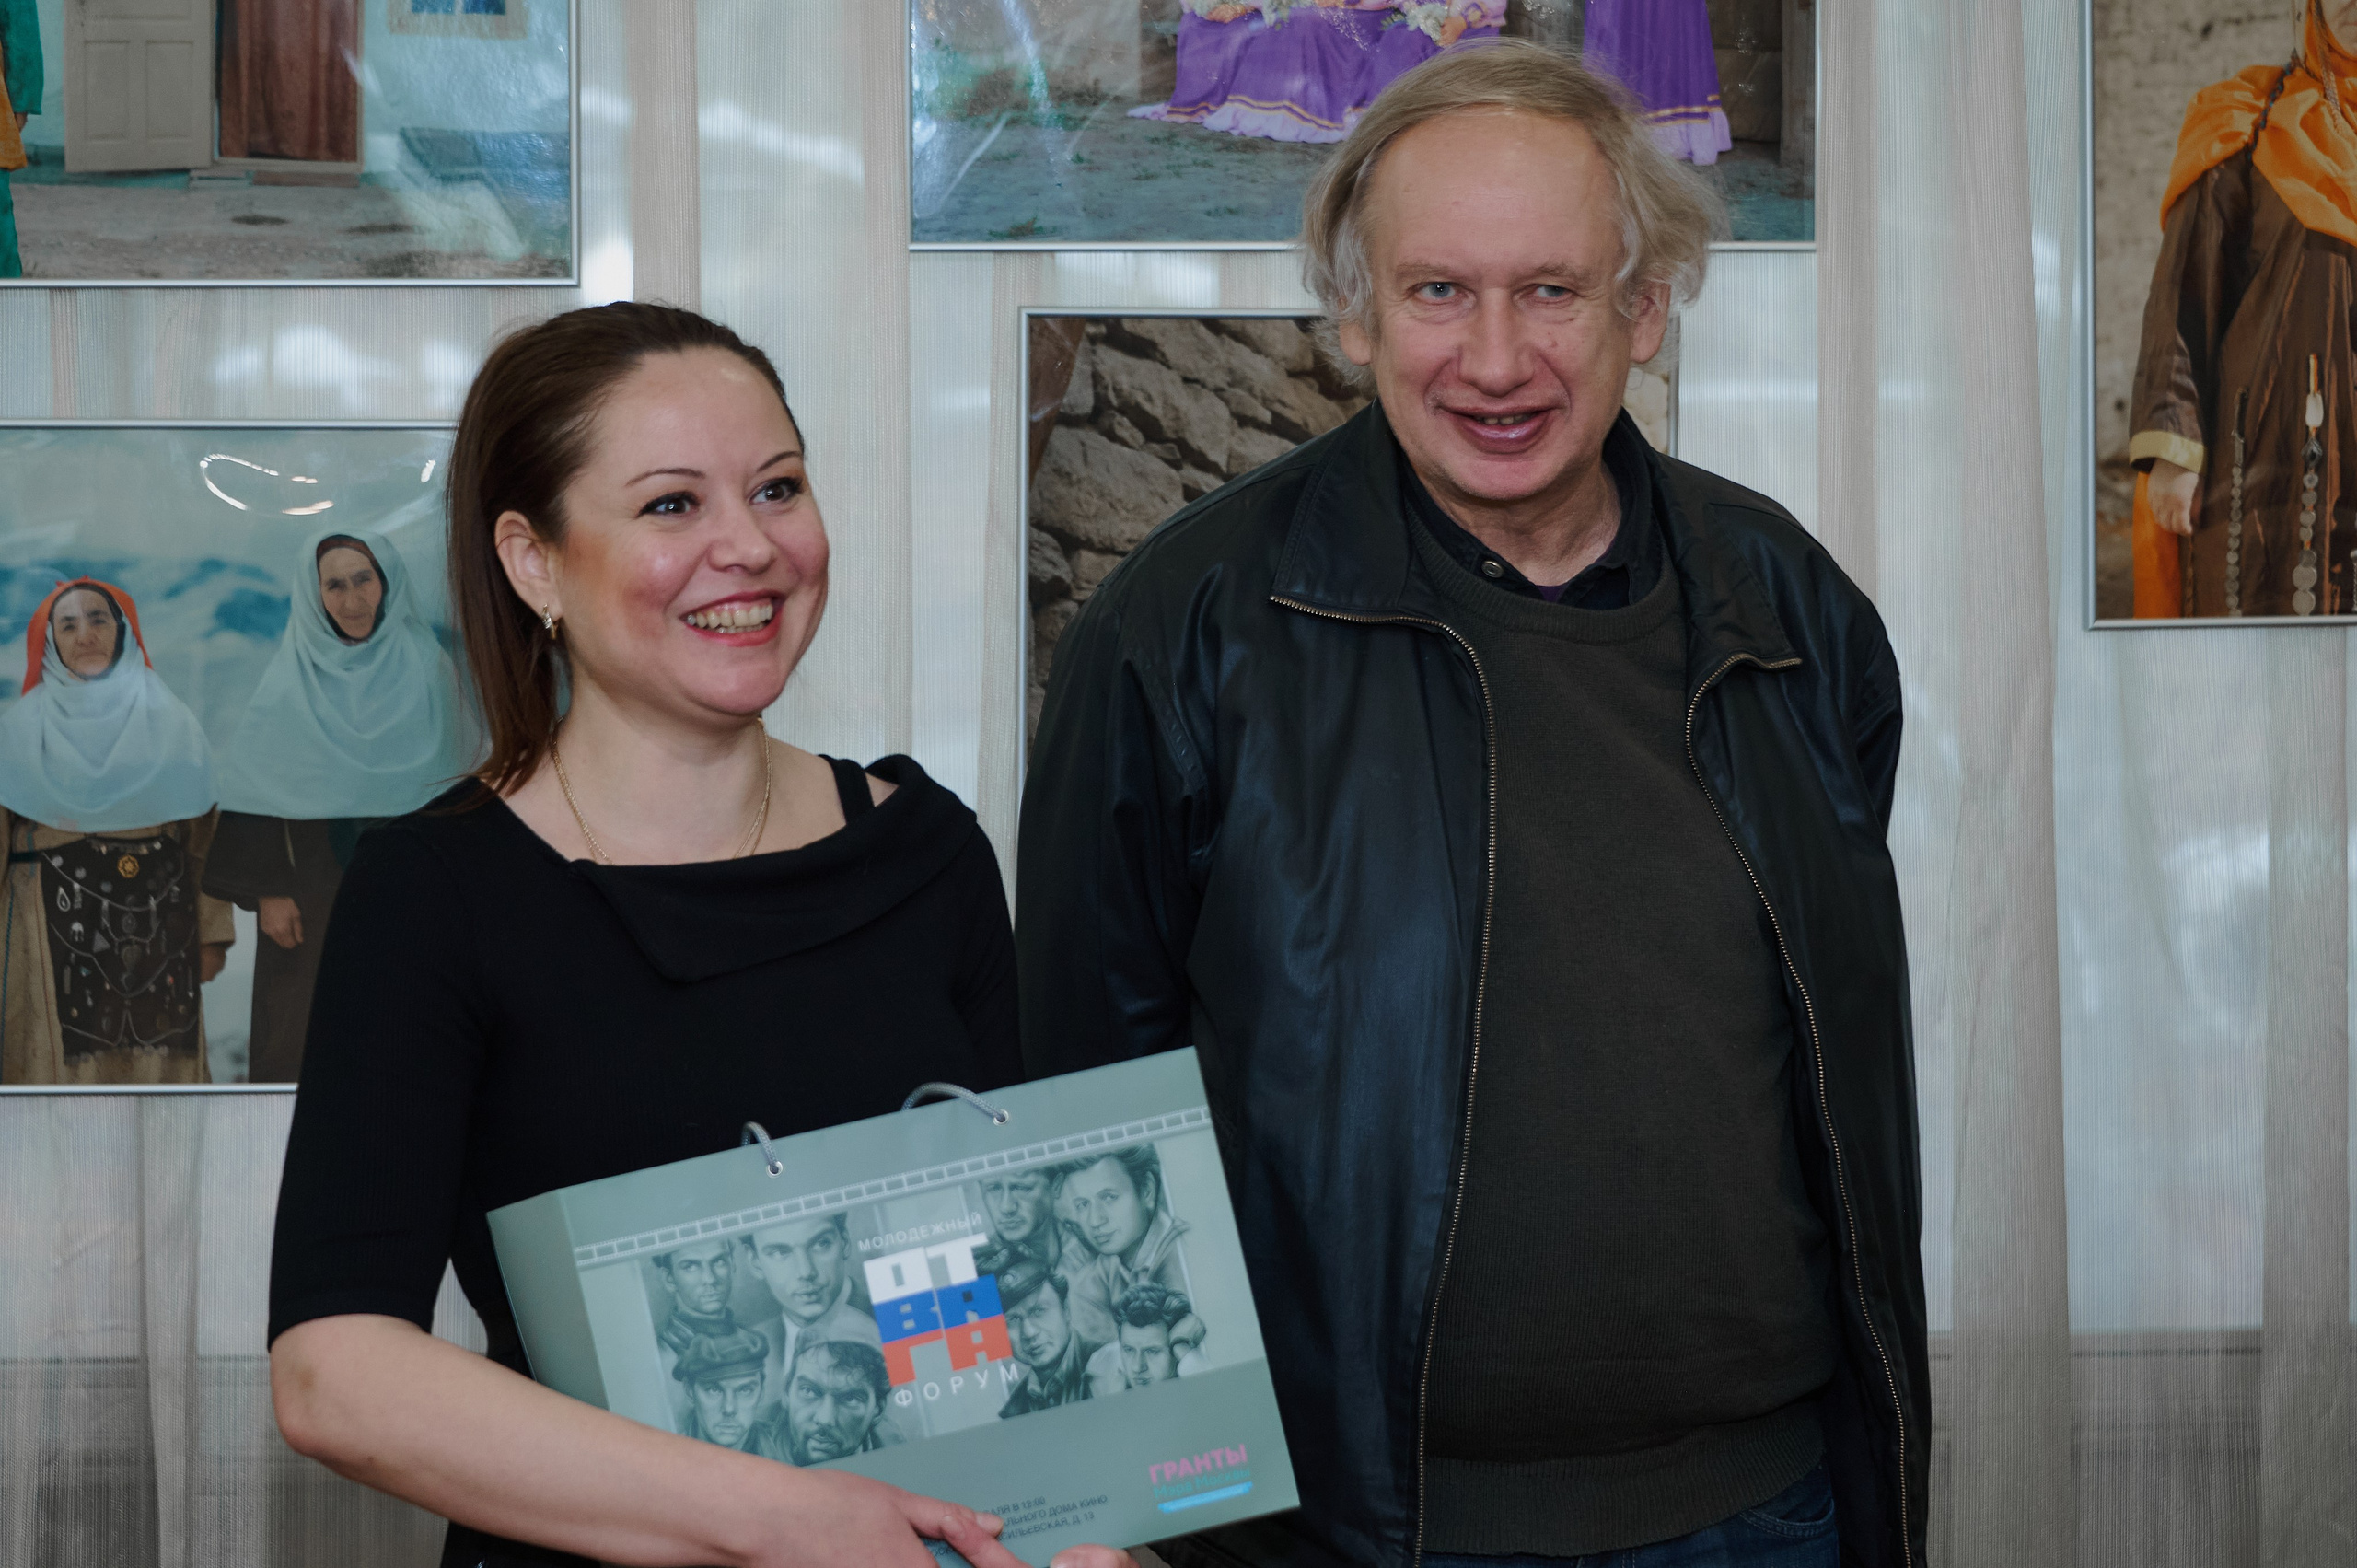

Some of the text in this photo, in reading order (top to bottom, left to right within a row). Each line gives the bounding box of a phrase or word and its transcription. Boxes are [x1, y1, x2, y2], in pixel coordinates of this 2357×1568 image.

[857, 1211, 982, 1251] МОЛОДЕЖНЫЙ
[863, 1232, 989, 1306] ОТ
[894, 1363, 1019, 1407] ФОРУМ
[1149, 1443, 1248, 1484] ГРАНТЫ
[1195, 1468, 1250, 1488] Москвы
[1004, 1494, 1108, 1527] ЛЬНОГО ДОМА КИНО
[1084, 1511, 1095, 1521] 13
